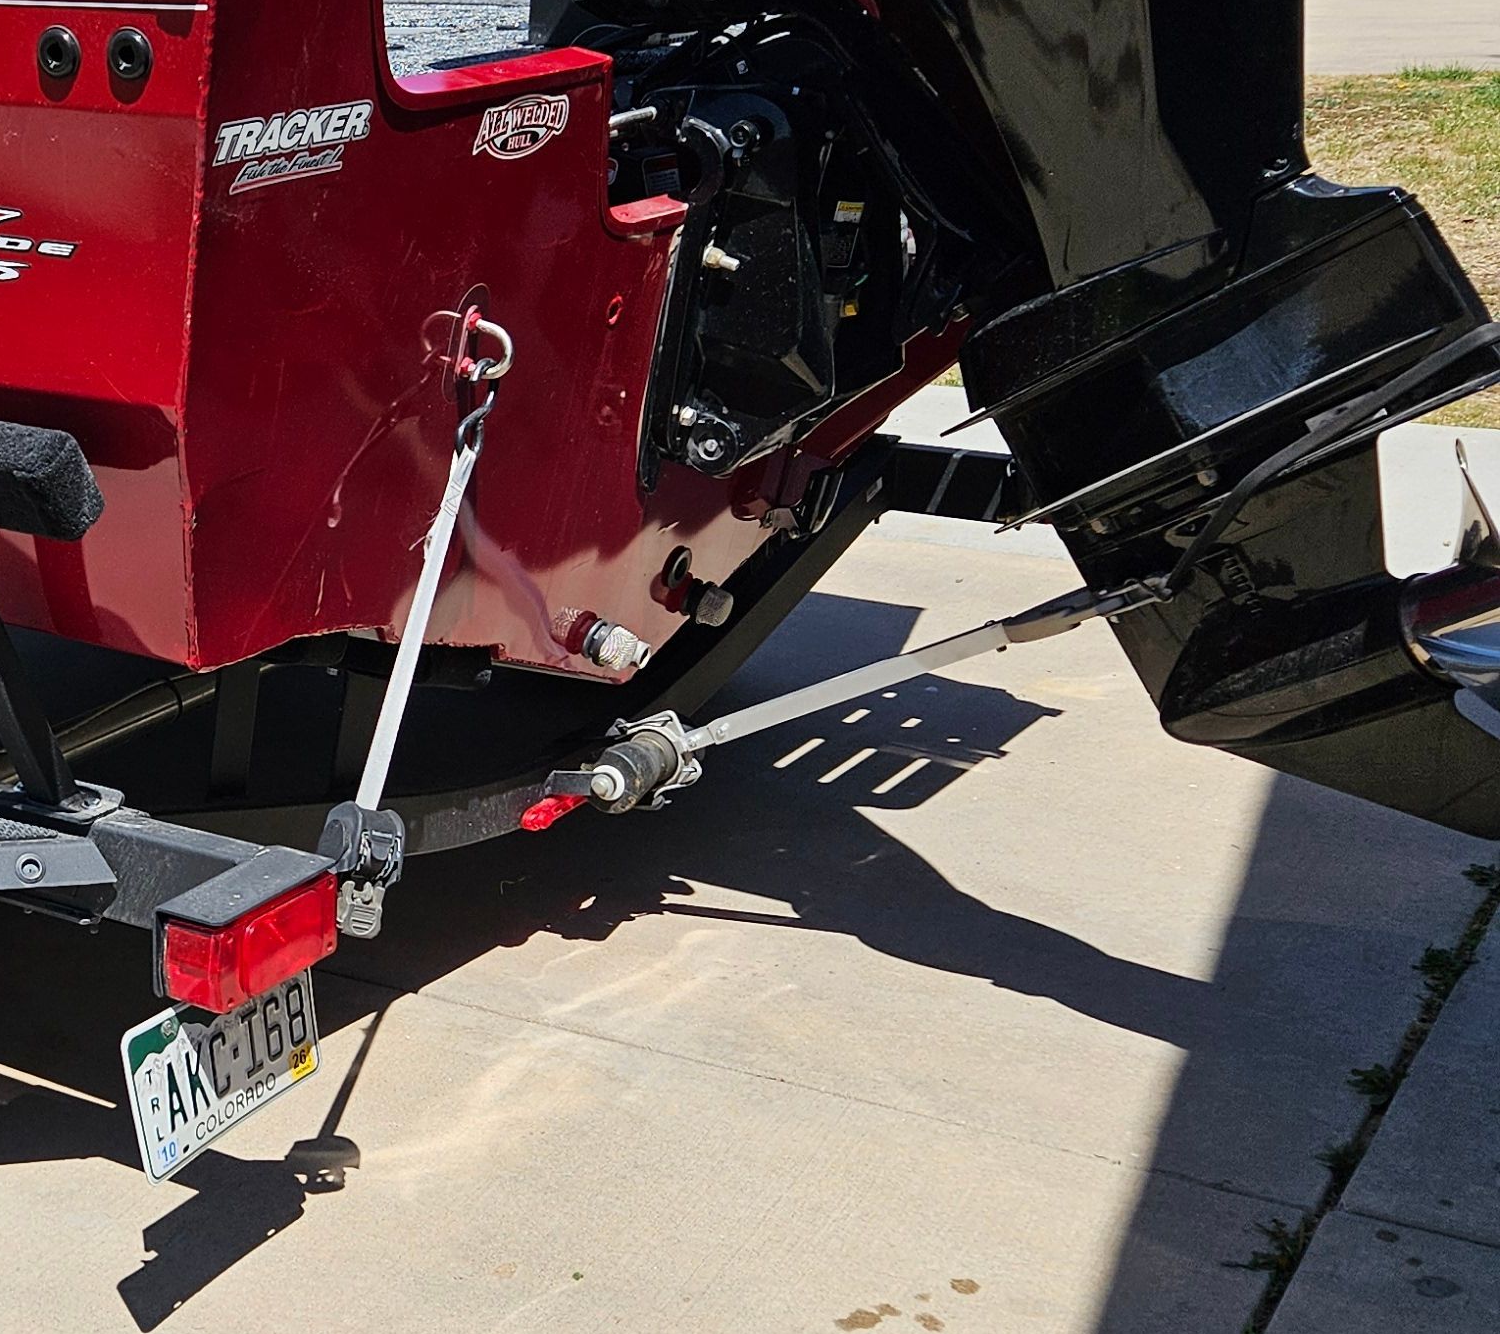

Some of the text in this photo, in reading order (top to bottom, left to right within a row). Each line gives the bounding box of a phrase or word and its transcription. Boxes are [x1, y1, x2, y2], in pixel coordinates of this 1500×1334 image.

[214, 102, 371, 164] TRACKER
[477, 100, 567, 145] ALL WELDED
[506, 136, 533, 151] HULL
[236, 160, 266, 184] Fish
[267, 159, 288, 176] the
[292, 1050, 306, 1068] 26
[195, 1072, 276, 1140] COLORADO
[161, 1141, 176, 1162] 10
